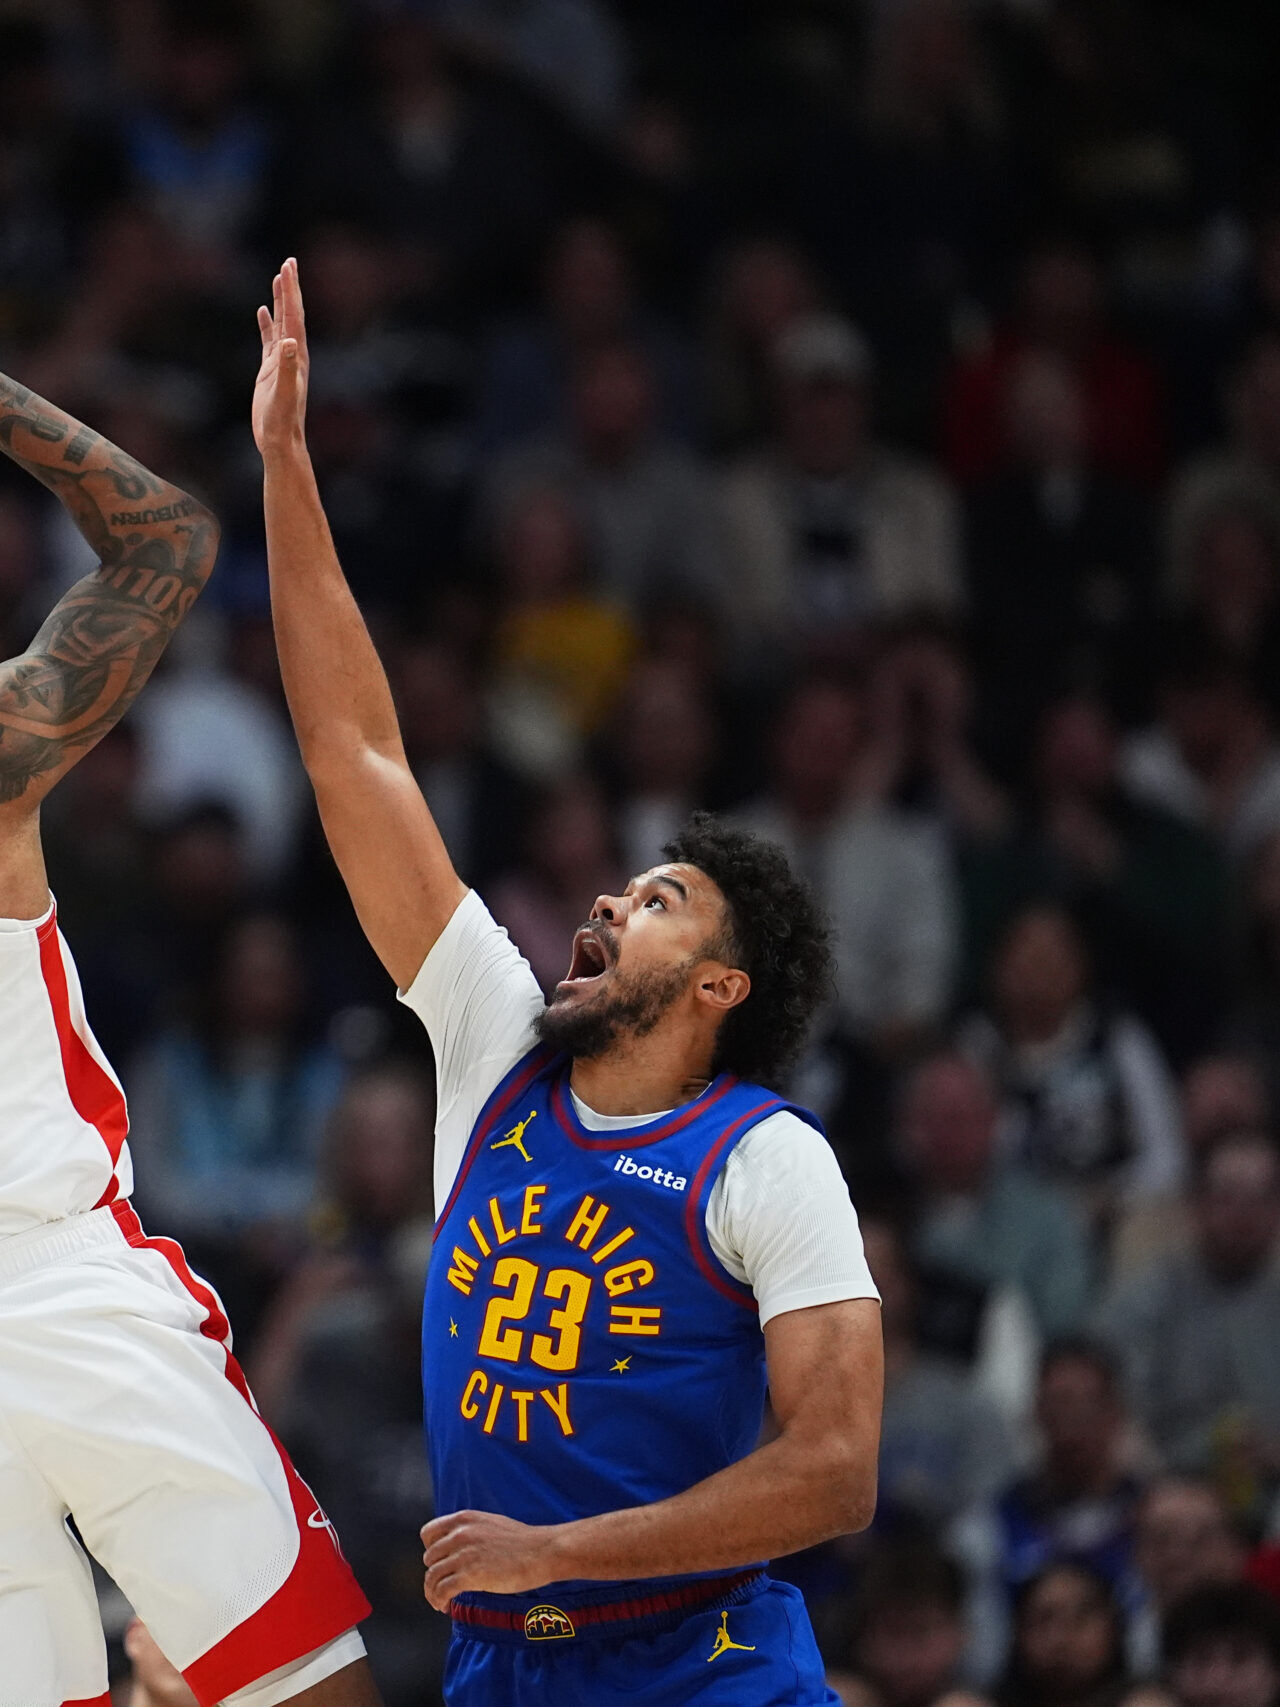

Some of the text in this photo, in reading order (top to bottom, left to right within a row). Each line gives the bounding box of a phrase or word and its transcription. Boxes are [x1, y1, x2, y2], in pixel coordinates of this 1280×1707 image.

[613, 1154, 687, 1191] ibotta
[447, 1185, 661, 1335] MILE HIGH
[478, 1257, 592, 1371] 23
[460, 1369, 573, 1441] CITY
